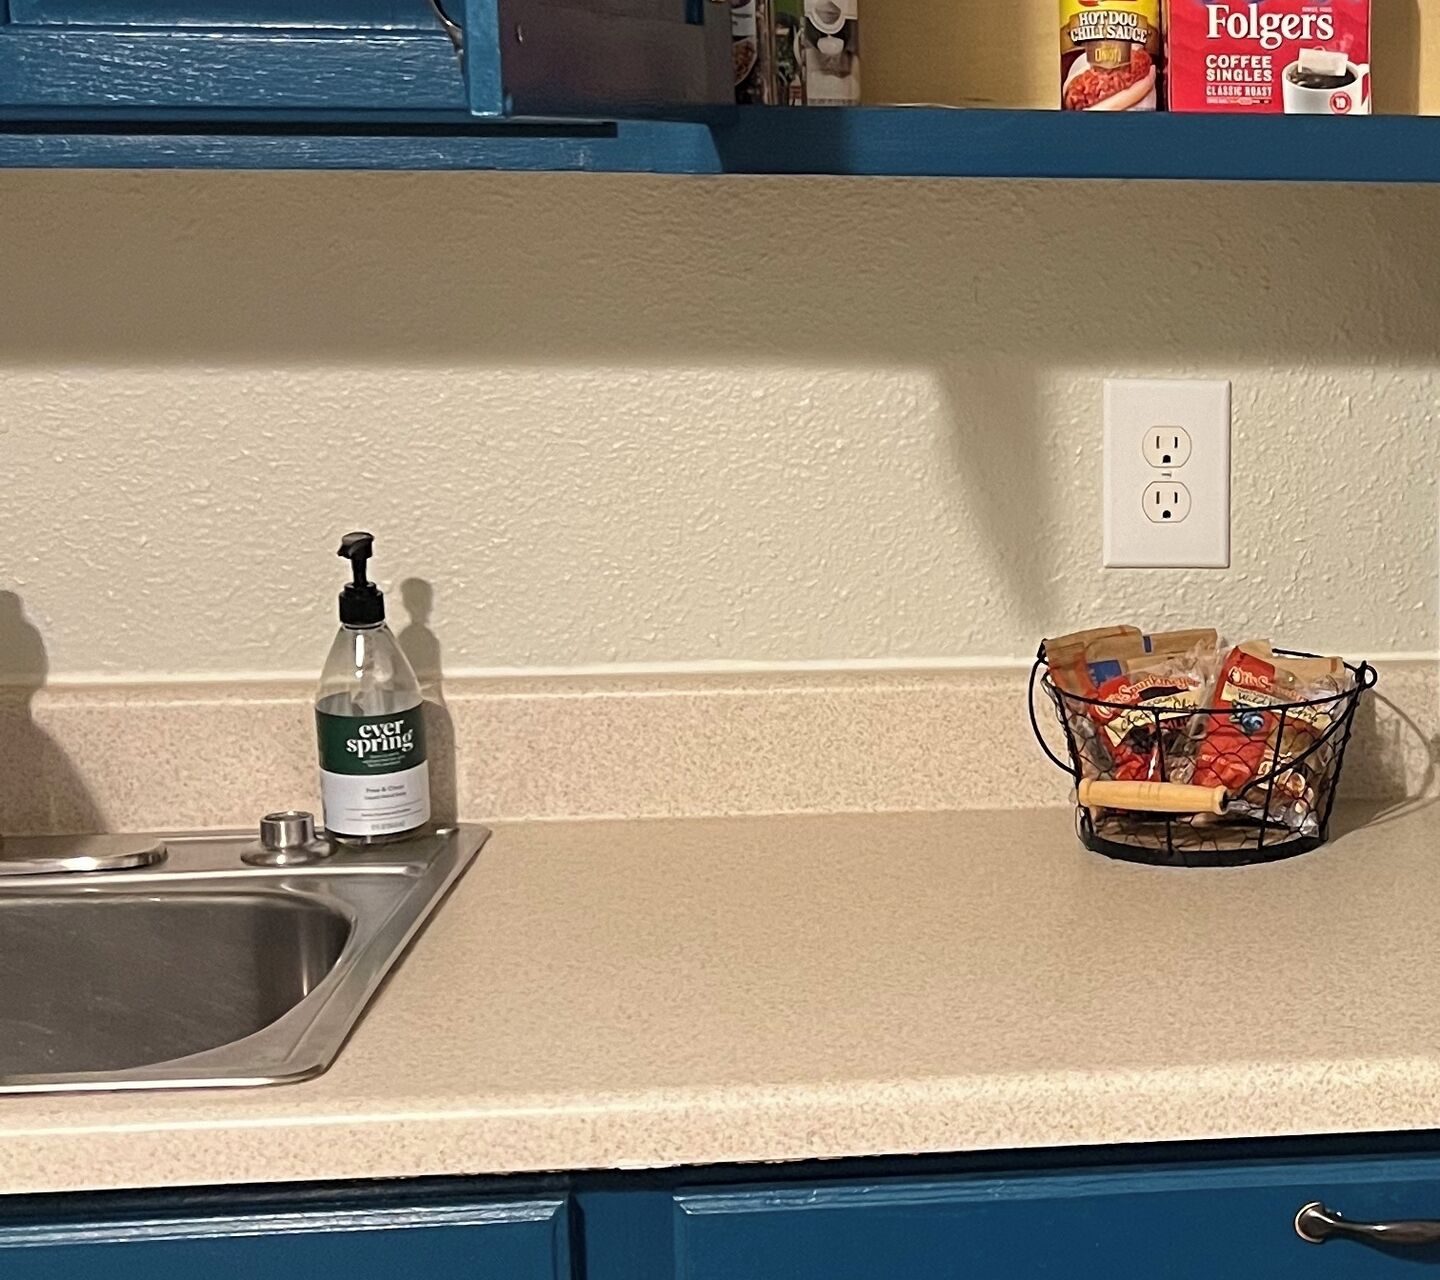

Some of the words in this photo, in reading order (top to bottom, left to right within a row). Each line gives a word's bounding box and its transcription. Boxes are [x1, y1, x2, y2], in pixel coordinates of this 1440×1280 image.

[1079, 11, 1107, 26] HOT
[1108, 11, 1137, 27] DOG
[1206, 3, 1335, 50] Folgers
[1070, 26, 1105, 43] CHILI
[1106, 24, 1148, 44] SAUCE
[1206, 54, 1272, 69] COFFEE
[1206, 69, 1273, 82] SINGLES
[1206, 85, 1243, 96] CLASSIC
[1245, 86, 1272, 96] ROAST
[358, 719, 404, 738] ever
[346, 728, 414, 758] spring
